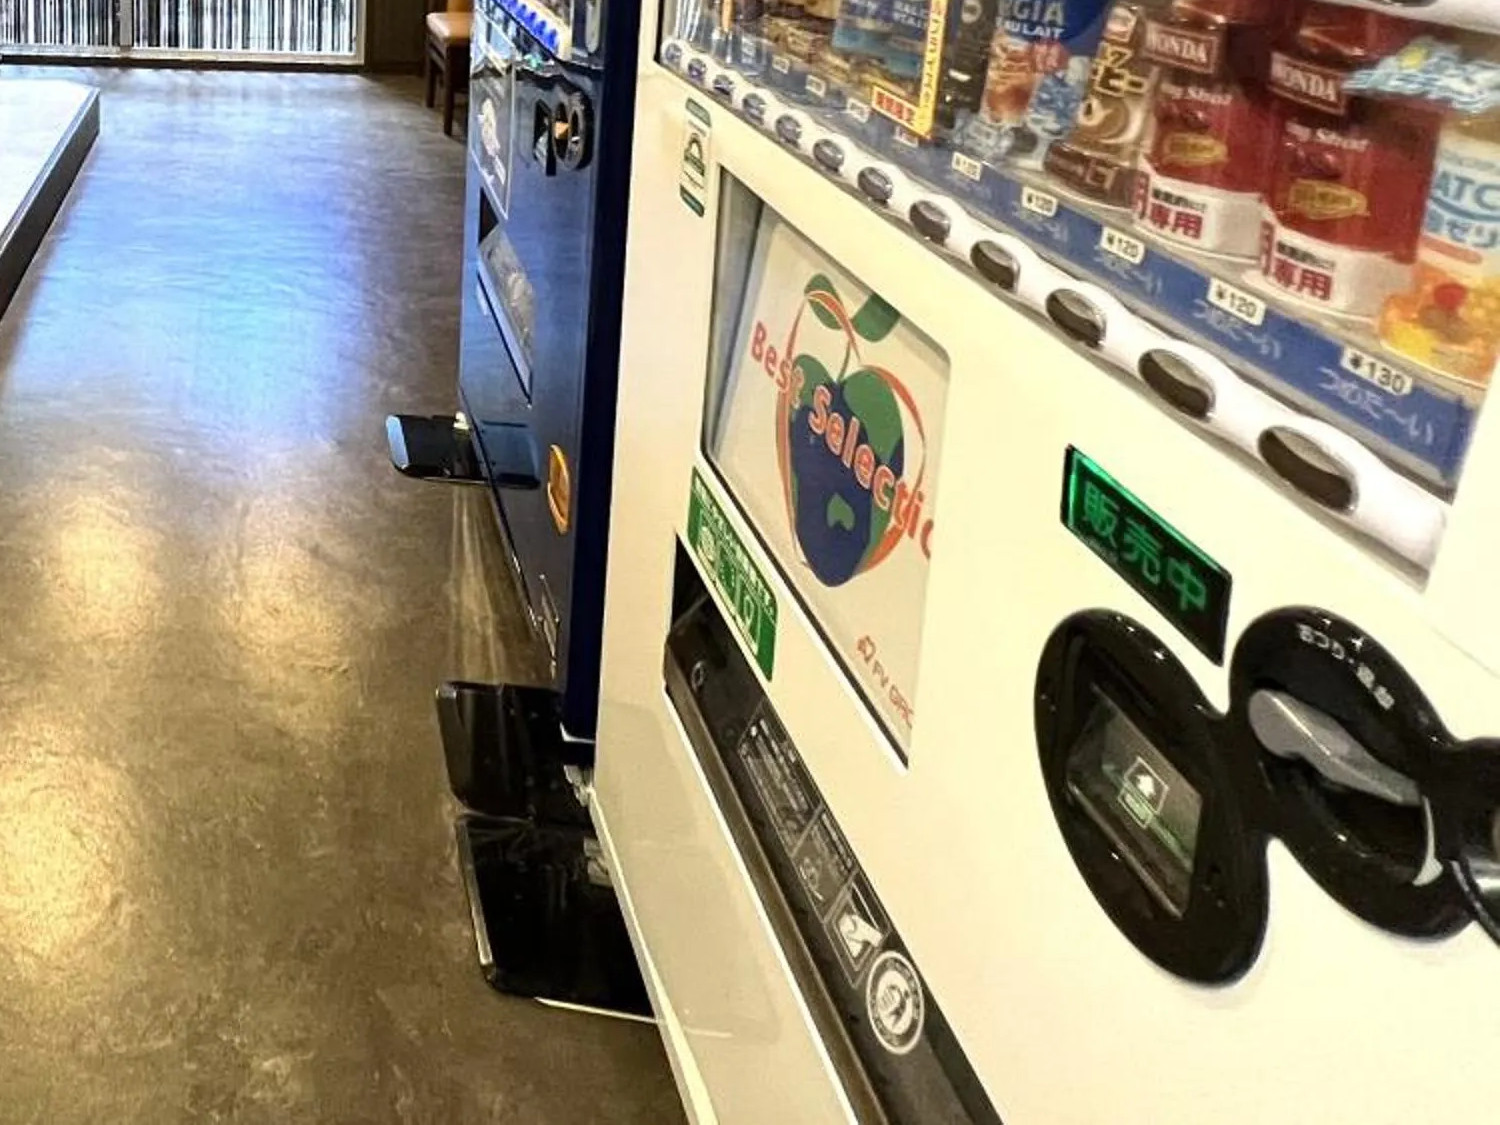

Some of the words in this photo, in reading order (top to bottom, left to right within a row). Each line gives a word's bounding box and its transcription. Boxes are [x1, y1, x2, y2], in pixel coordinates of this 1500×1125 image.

[1215, 283, 1258, 318] ¥120
[1348, 352, 1406, 394] ¥130
[1083, 479, 1208, 613] 販売中
